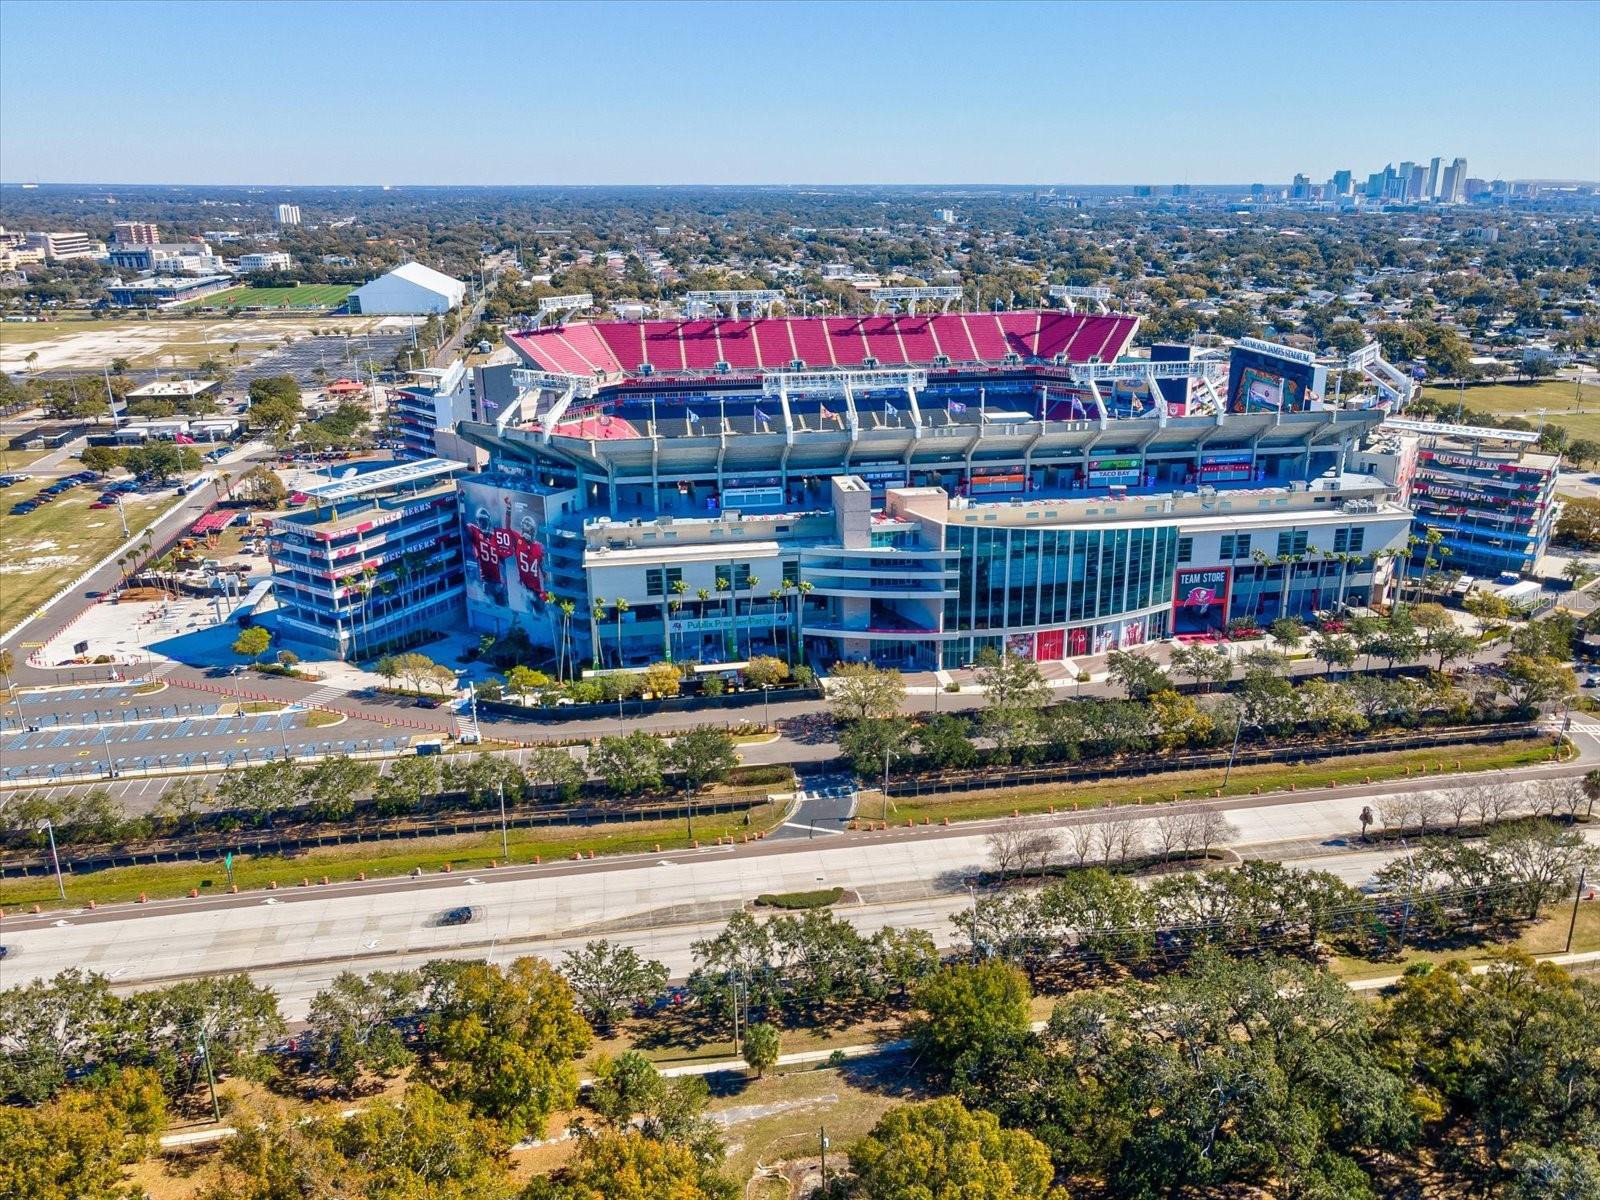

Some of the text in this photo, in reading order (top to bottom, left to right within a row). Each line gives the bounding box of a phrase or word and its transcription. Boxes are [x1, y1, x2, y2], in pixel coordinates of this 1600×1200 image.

[1240, 340, 1310, 362] RAYMOND JAMES STADIUM
[496, 531, 510, 546] 50
[479, 541, 498, 565] 55
[519, 552, 538, 577] 54
[1181, 572, 1225, 585] TEAM STORE
[687, 621, 713, 629] Publix
